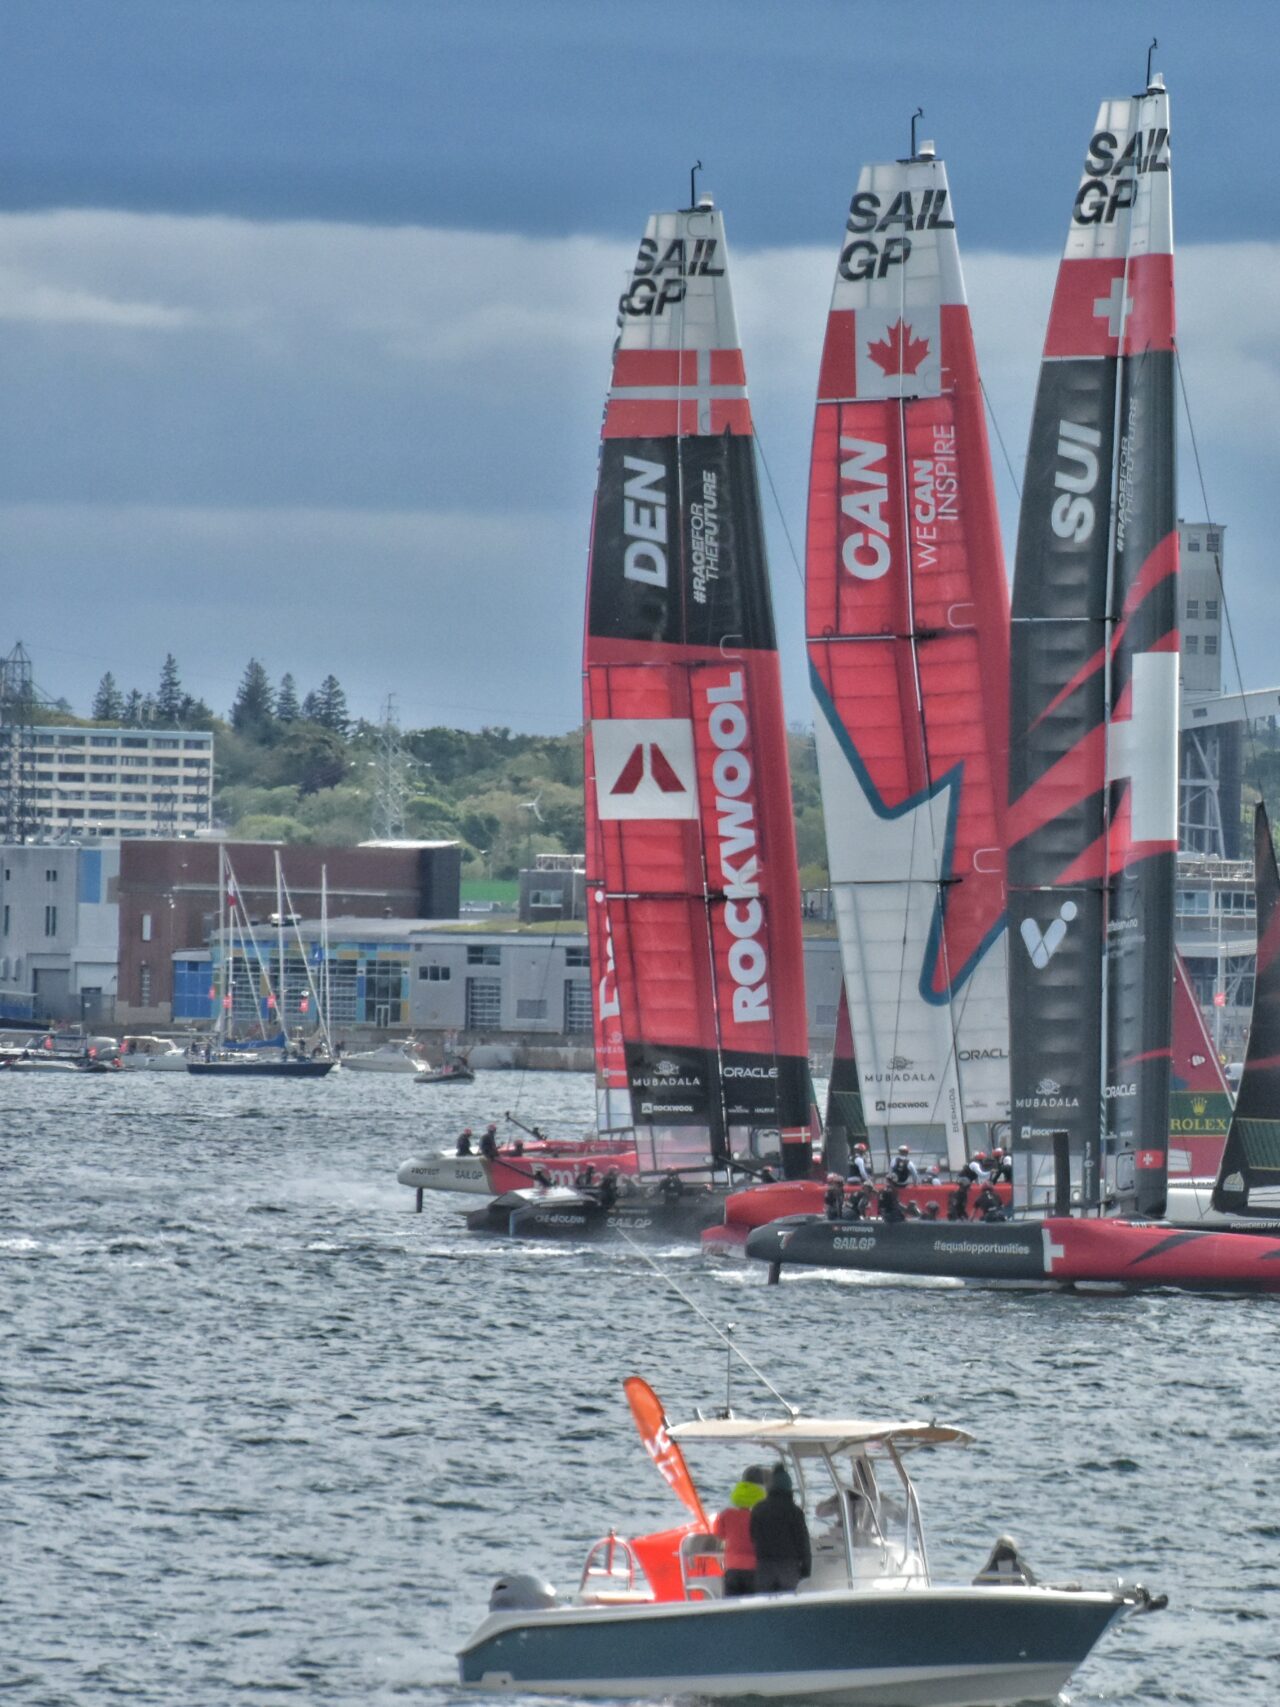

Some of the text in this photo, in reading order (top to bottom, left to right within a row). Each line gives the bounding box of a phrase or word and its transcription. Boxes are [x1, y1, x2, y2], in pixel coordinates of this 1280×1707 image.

[1084, 128, 1168, 177] SAIL
[846, 189, 955, 234] SAIL
[1072, 180, 1138, 225] GP
[634, 237, 725, 276] SAIL
[838, 237, 912, 281] GP
[626, 278, 687, 316] GP
[933, 424, 959, 520] INSPIRE
[1051, 419, 1102, 544] SUI
[1116, 436, 1129, 552] #RACEFOR
[623, 455, 668, 588] DEN
[703, 470, 719, 581] THEFUTURE
[840, 435, 891, 580] CAN
[913, 459, 937, 568] WE CAN
[691, 502, 706, 604] #RACEFOR
[706, 671, 771, 1023] ROCKWOOL
[723, 1067, 778, 1078] ORACLE
[958, 1048, 1009, 1062] ORACL
[632, 1076, 700, 1087] MUBADALA
[864, 1073, 936, 1083] MUBADALA
[1105, 1083, 1137, 1099] ORACLE
[653, 1104, 694, 1112] ROCKWOOL
[887, 1101, 929, 1109] ROCKWOOL
[1015, 1097, 1079, 1108] MUBADALA
[1169, 1118, 1228, 1131] ROLEX
[933, 1240, 1031, 1255] #equalopportunities
